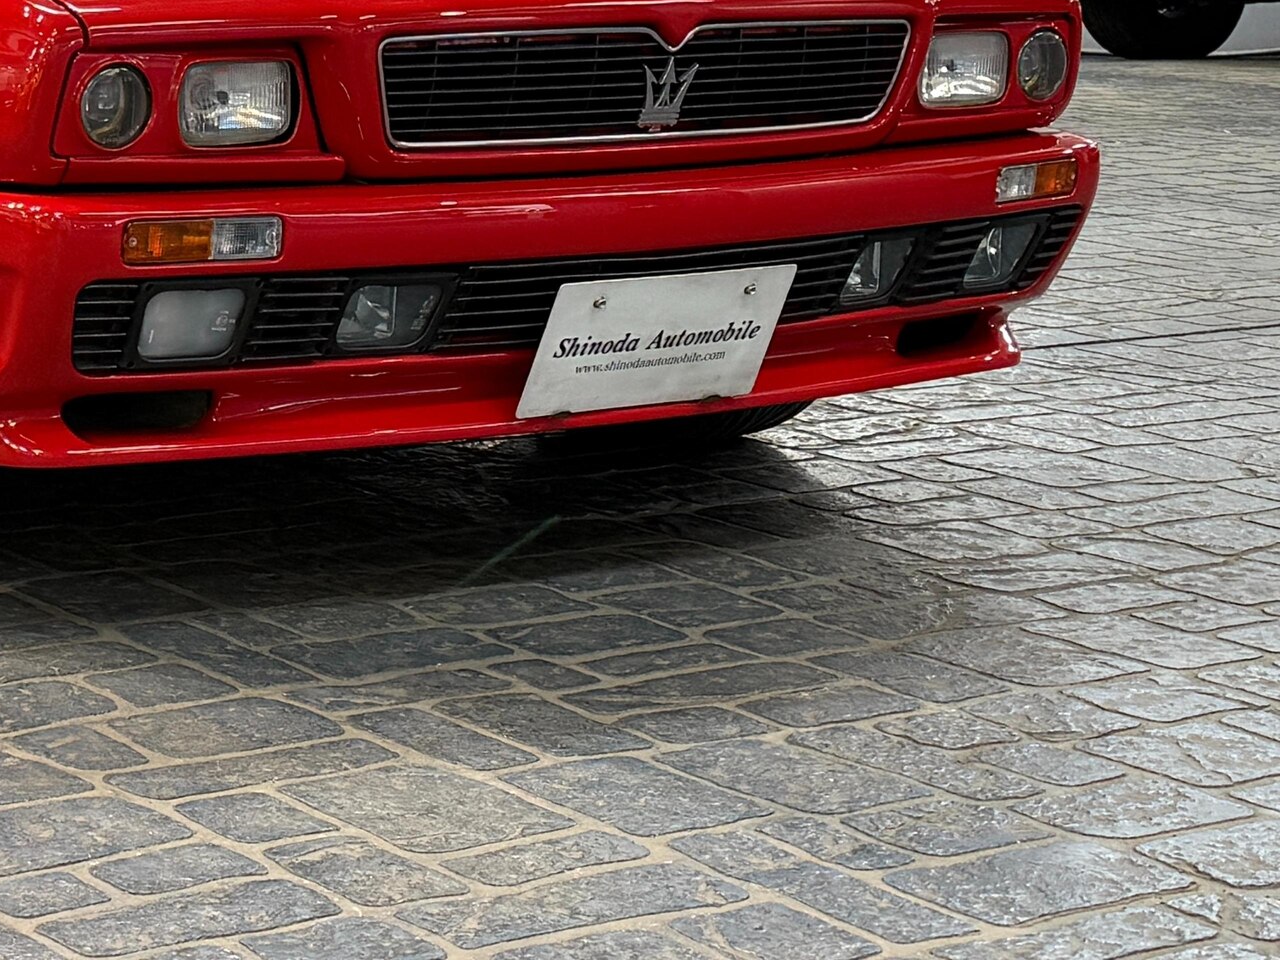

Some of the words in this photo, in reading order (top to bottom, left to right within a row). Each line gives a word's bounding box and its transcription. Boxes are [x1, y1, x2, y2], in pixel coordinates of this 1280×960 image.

[553, 333, 641, 358] Shinoda
[645, 320, 761, 350] Automobile
[575, 351, 726, 374] www.shinodaautomobile.com
